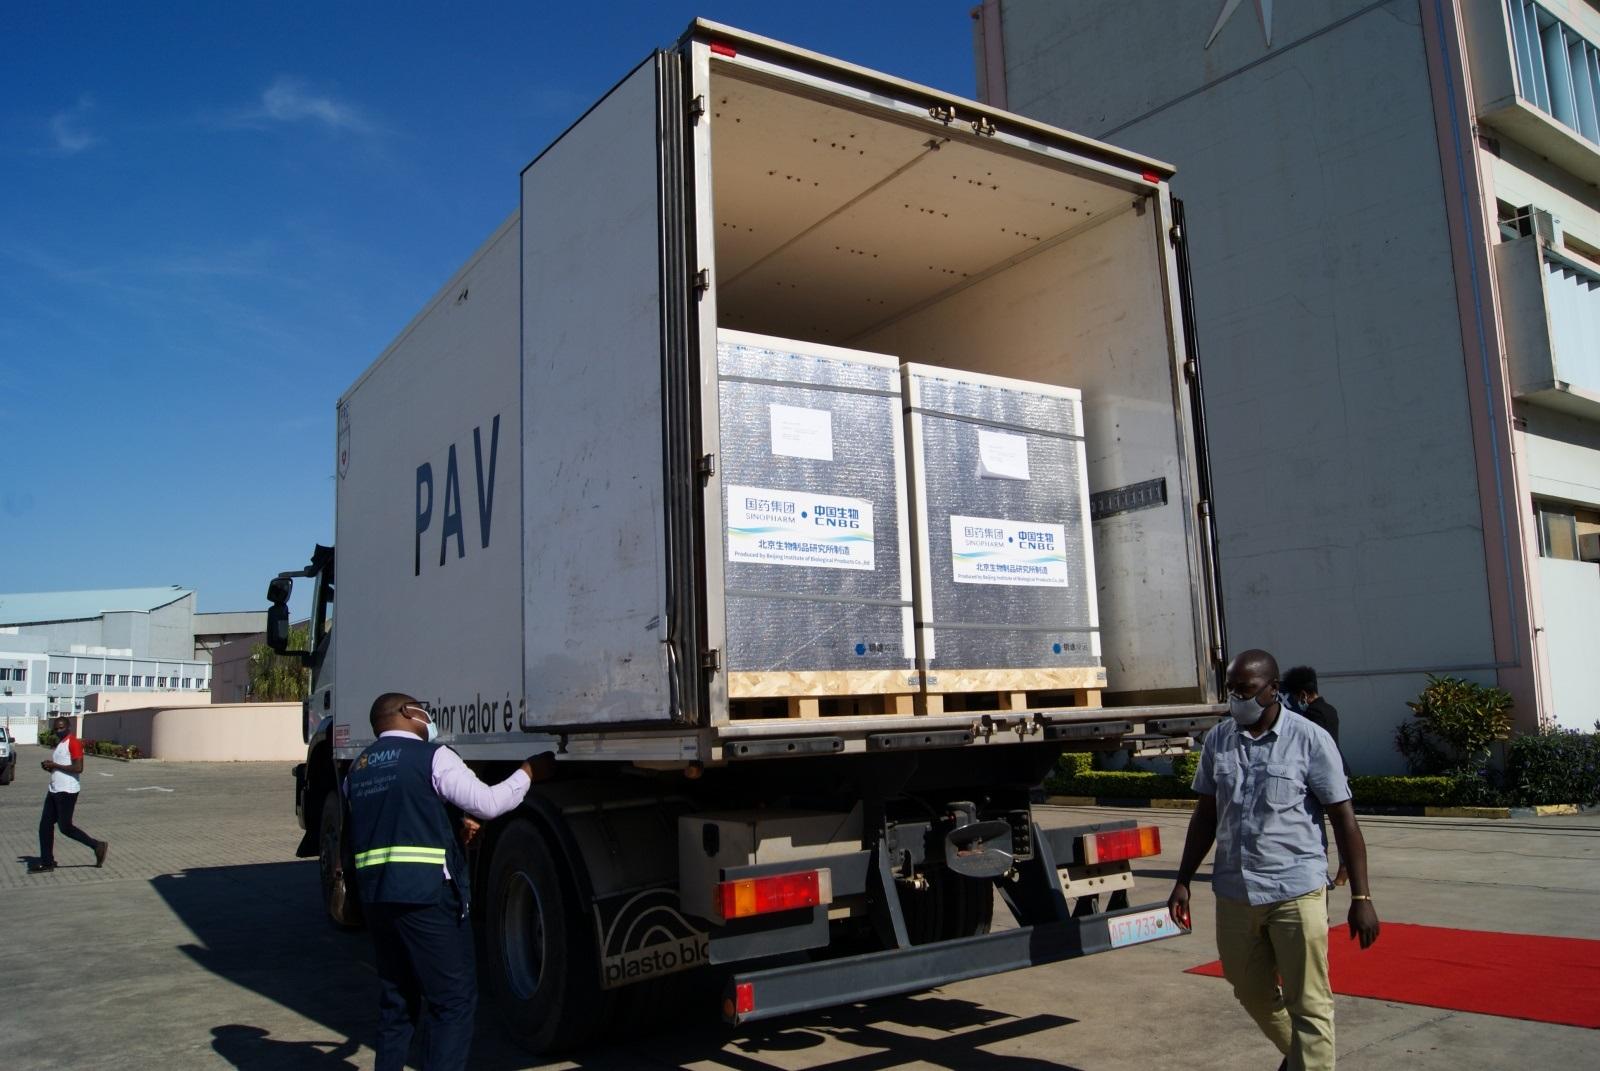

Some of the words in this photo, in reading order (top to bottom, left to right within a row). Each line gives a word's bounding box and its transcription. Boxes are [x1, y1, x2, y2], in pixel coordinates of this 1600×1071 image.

[415, 414, 500, 577] PAV
[745, 497, 795, 514] 国药集团
[814, 505, 859, 520] 中国生物
[746, 512, 796, 524] SINOPHARM
[815, 517, 860, 529] CNBG
[964, 526, 1004, 540] 国药集团
[1018, 530, 1054, 543] 中国生物
[1019, 541, 1055, 551] CNBG
[459, 692, 499, 734] valor
